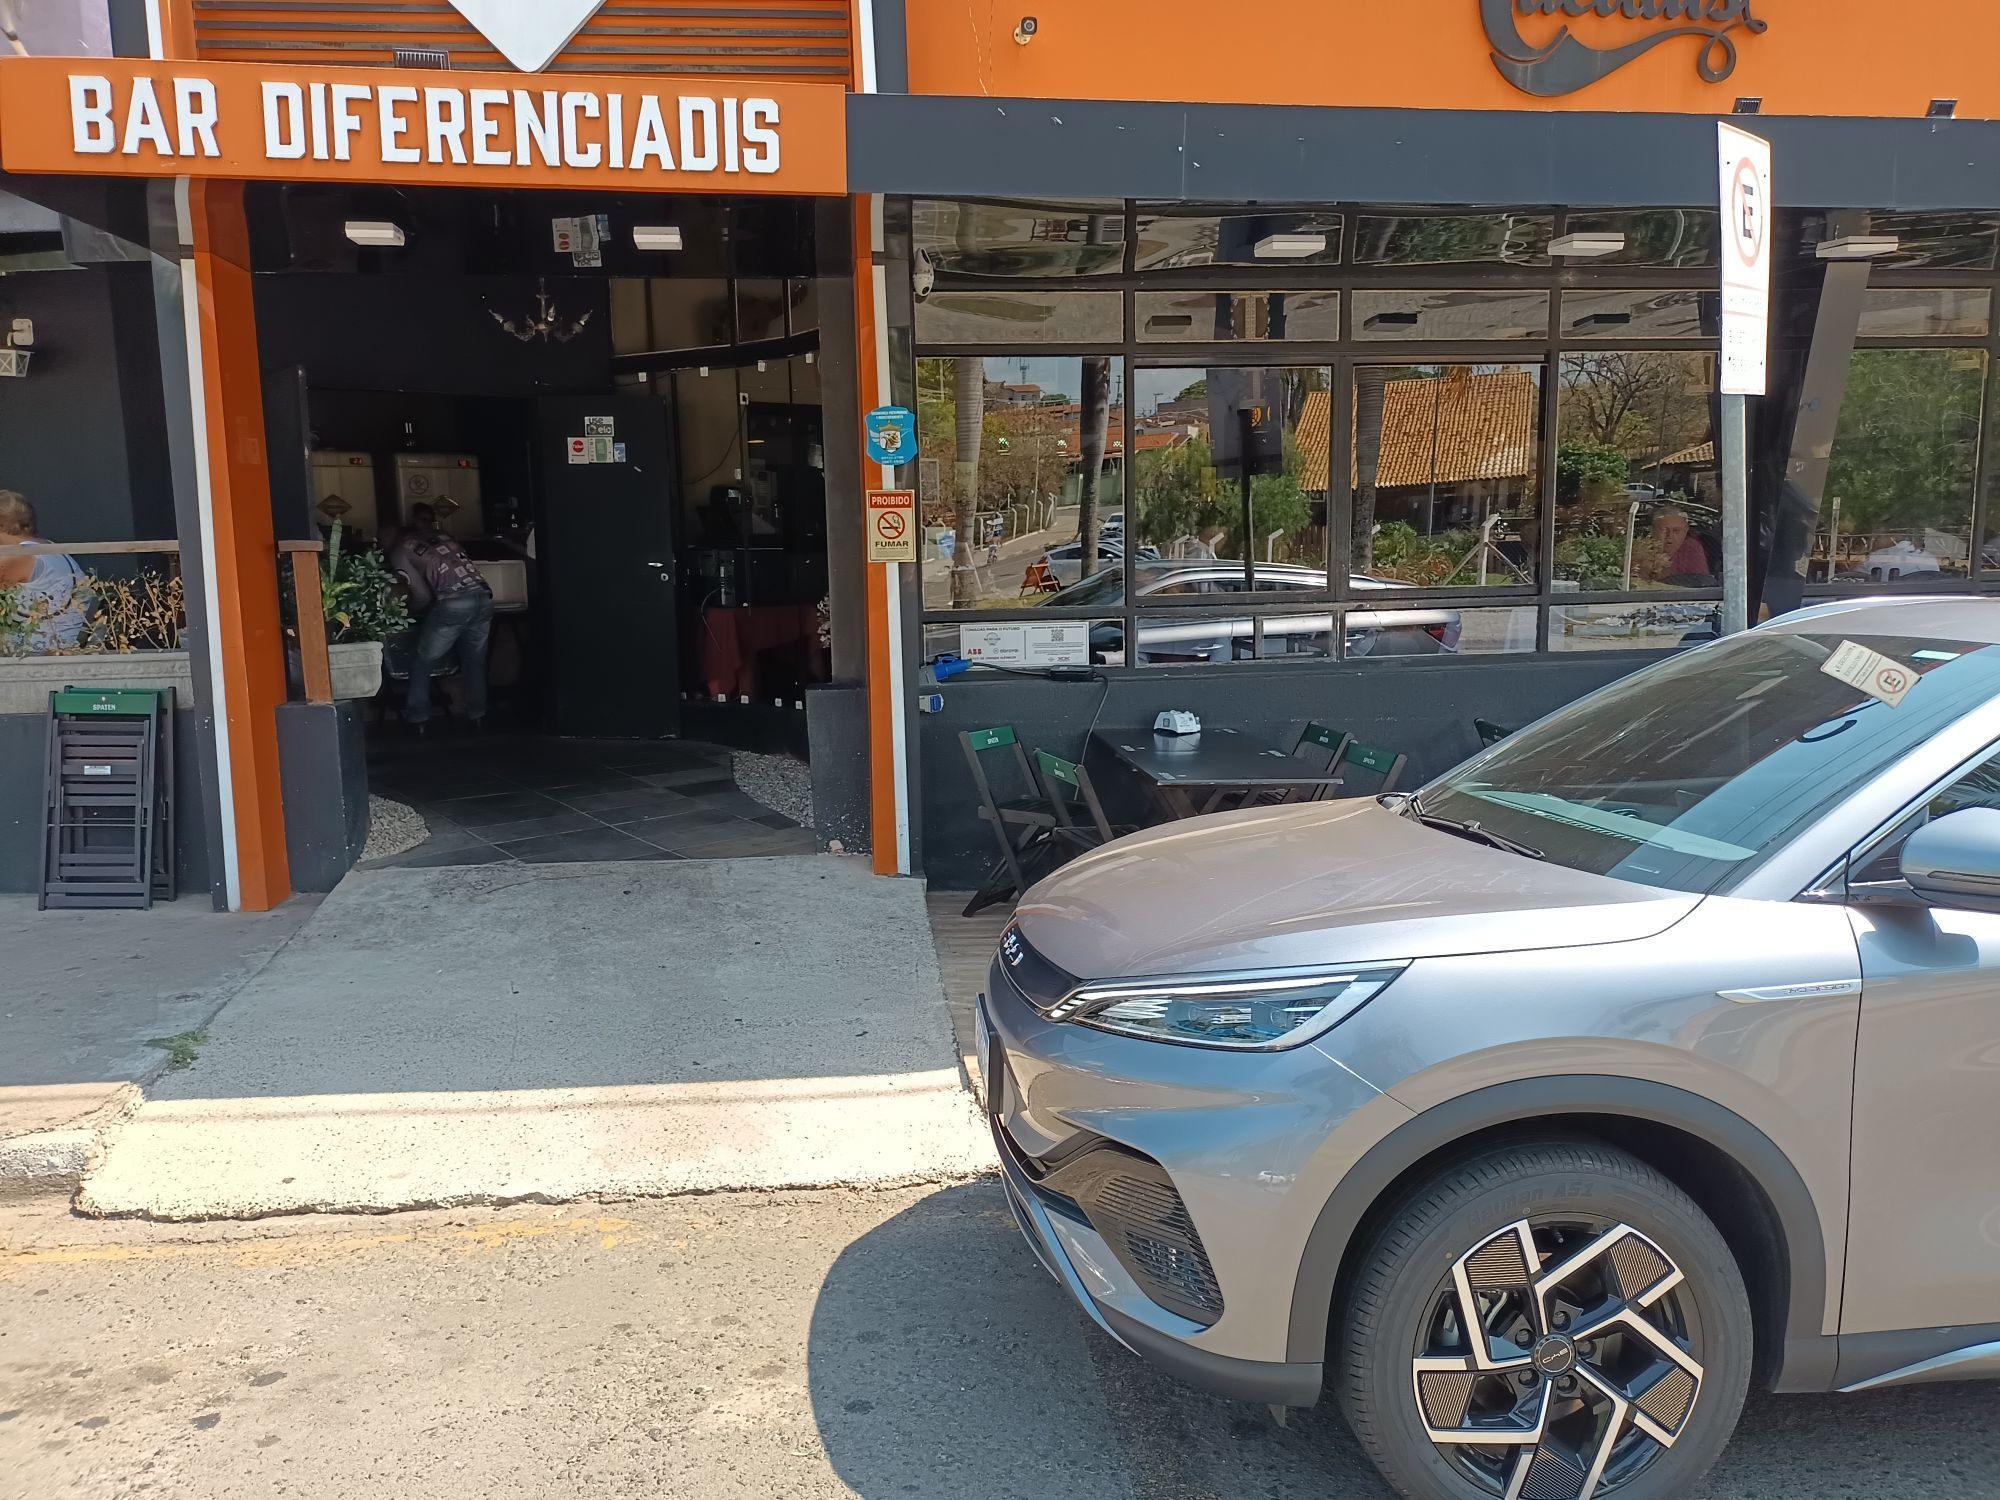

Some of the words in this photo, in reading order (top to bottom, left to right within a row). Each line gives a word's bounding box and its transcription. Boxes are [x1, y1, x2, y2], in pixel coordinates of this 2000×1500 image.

[68, 74, 221, 157] BAR
[260, 80, 782, 175] DIFERENCIADIS
[871, 495, 910, 506] PROIBIDO
[874, 540, 909, 548] FUMAR
